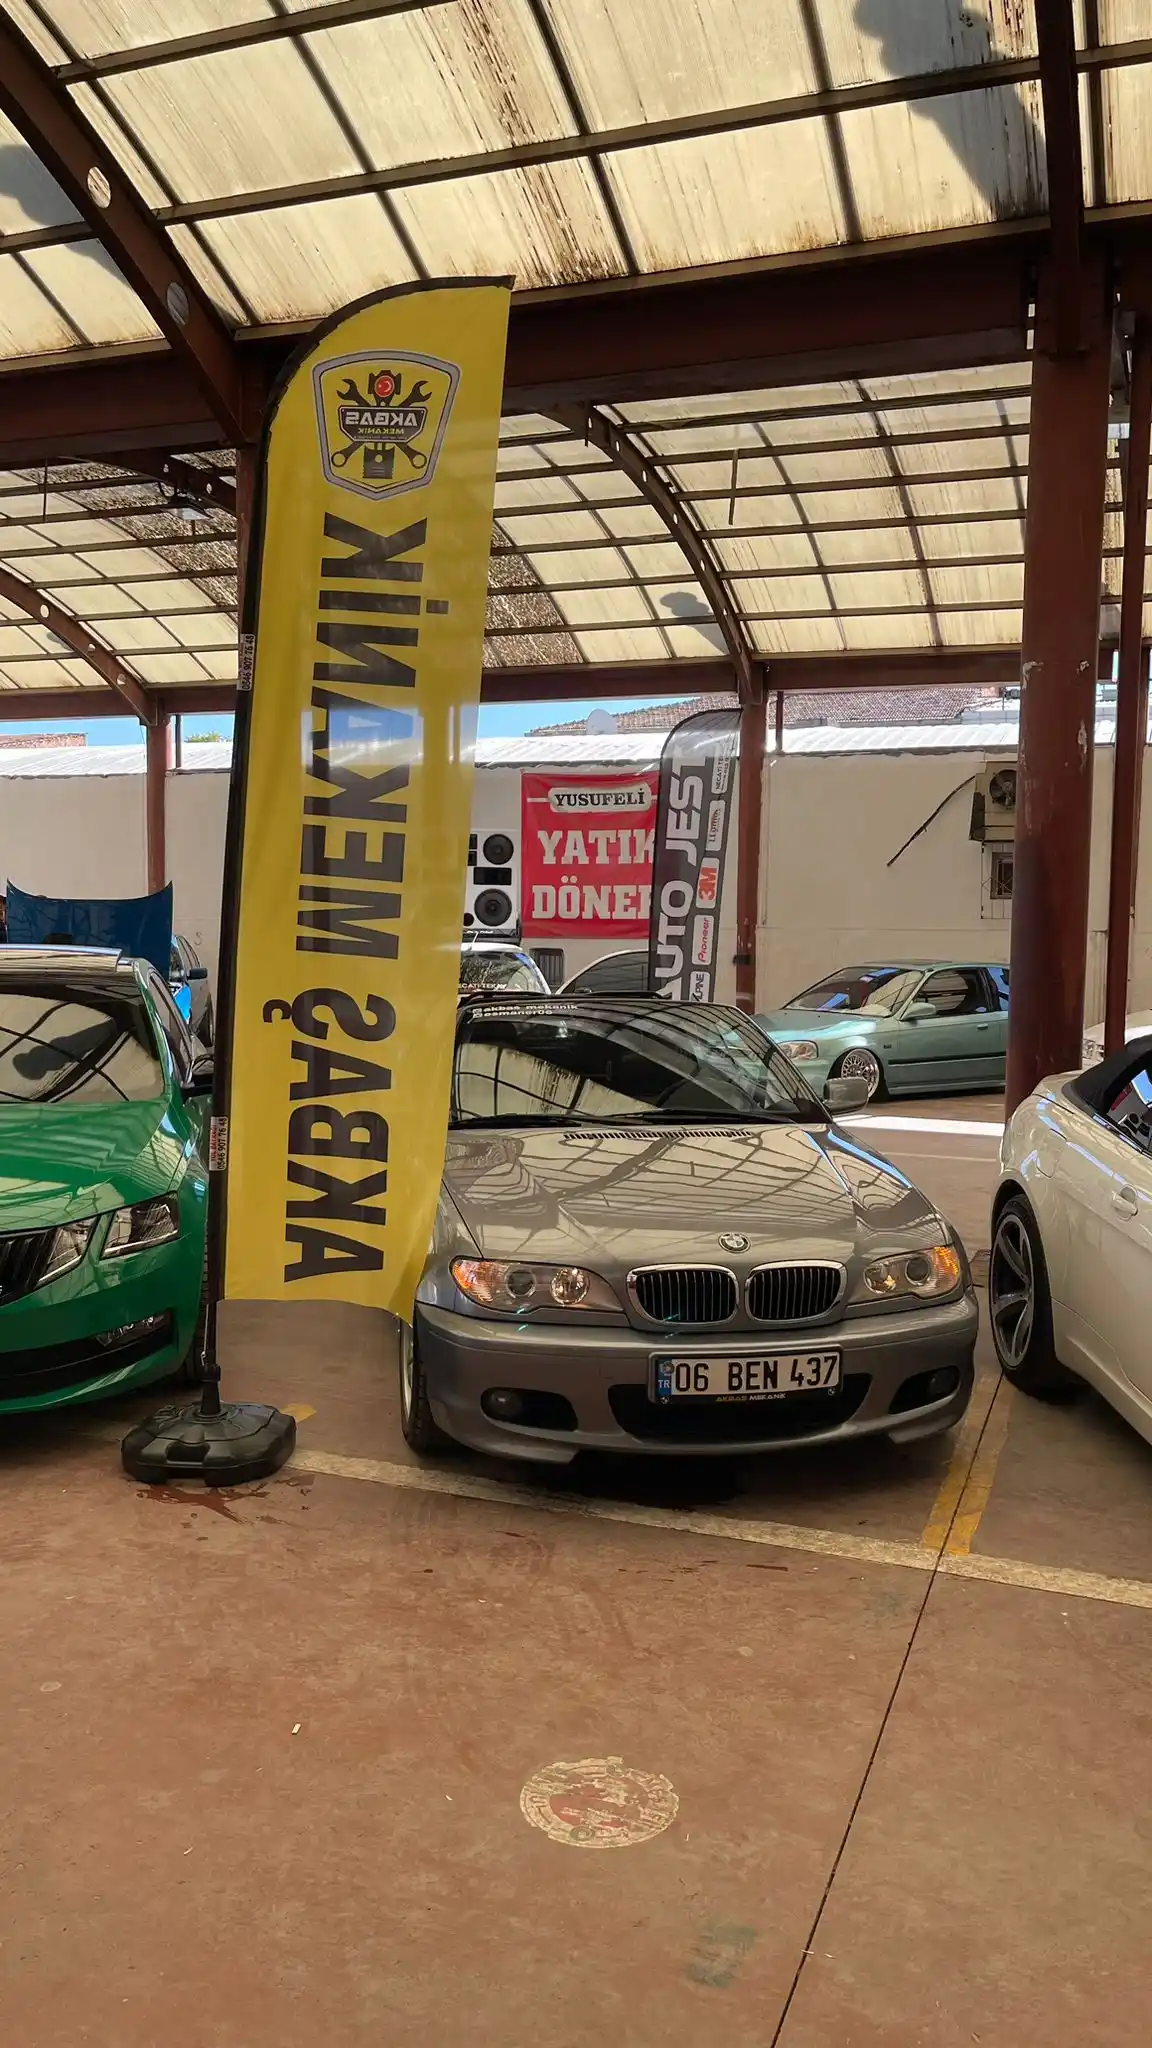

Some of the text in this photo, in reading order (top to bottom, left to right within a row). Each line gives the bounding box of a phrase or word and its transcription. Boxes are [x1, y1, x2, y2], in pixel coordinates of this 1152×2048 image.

[555, 788, 645, 807] YUSUFELİ
[665, 745, 707, 867] JEST
[698, 866, 718, 902] 3M
[698, 917, 711, 963] Pioneer
[218, 1139, 226, 1151] 907
[658, 1379, 671, 1389] TR
[675, 1355, 838, 1392] 06 BEN 437
